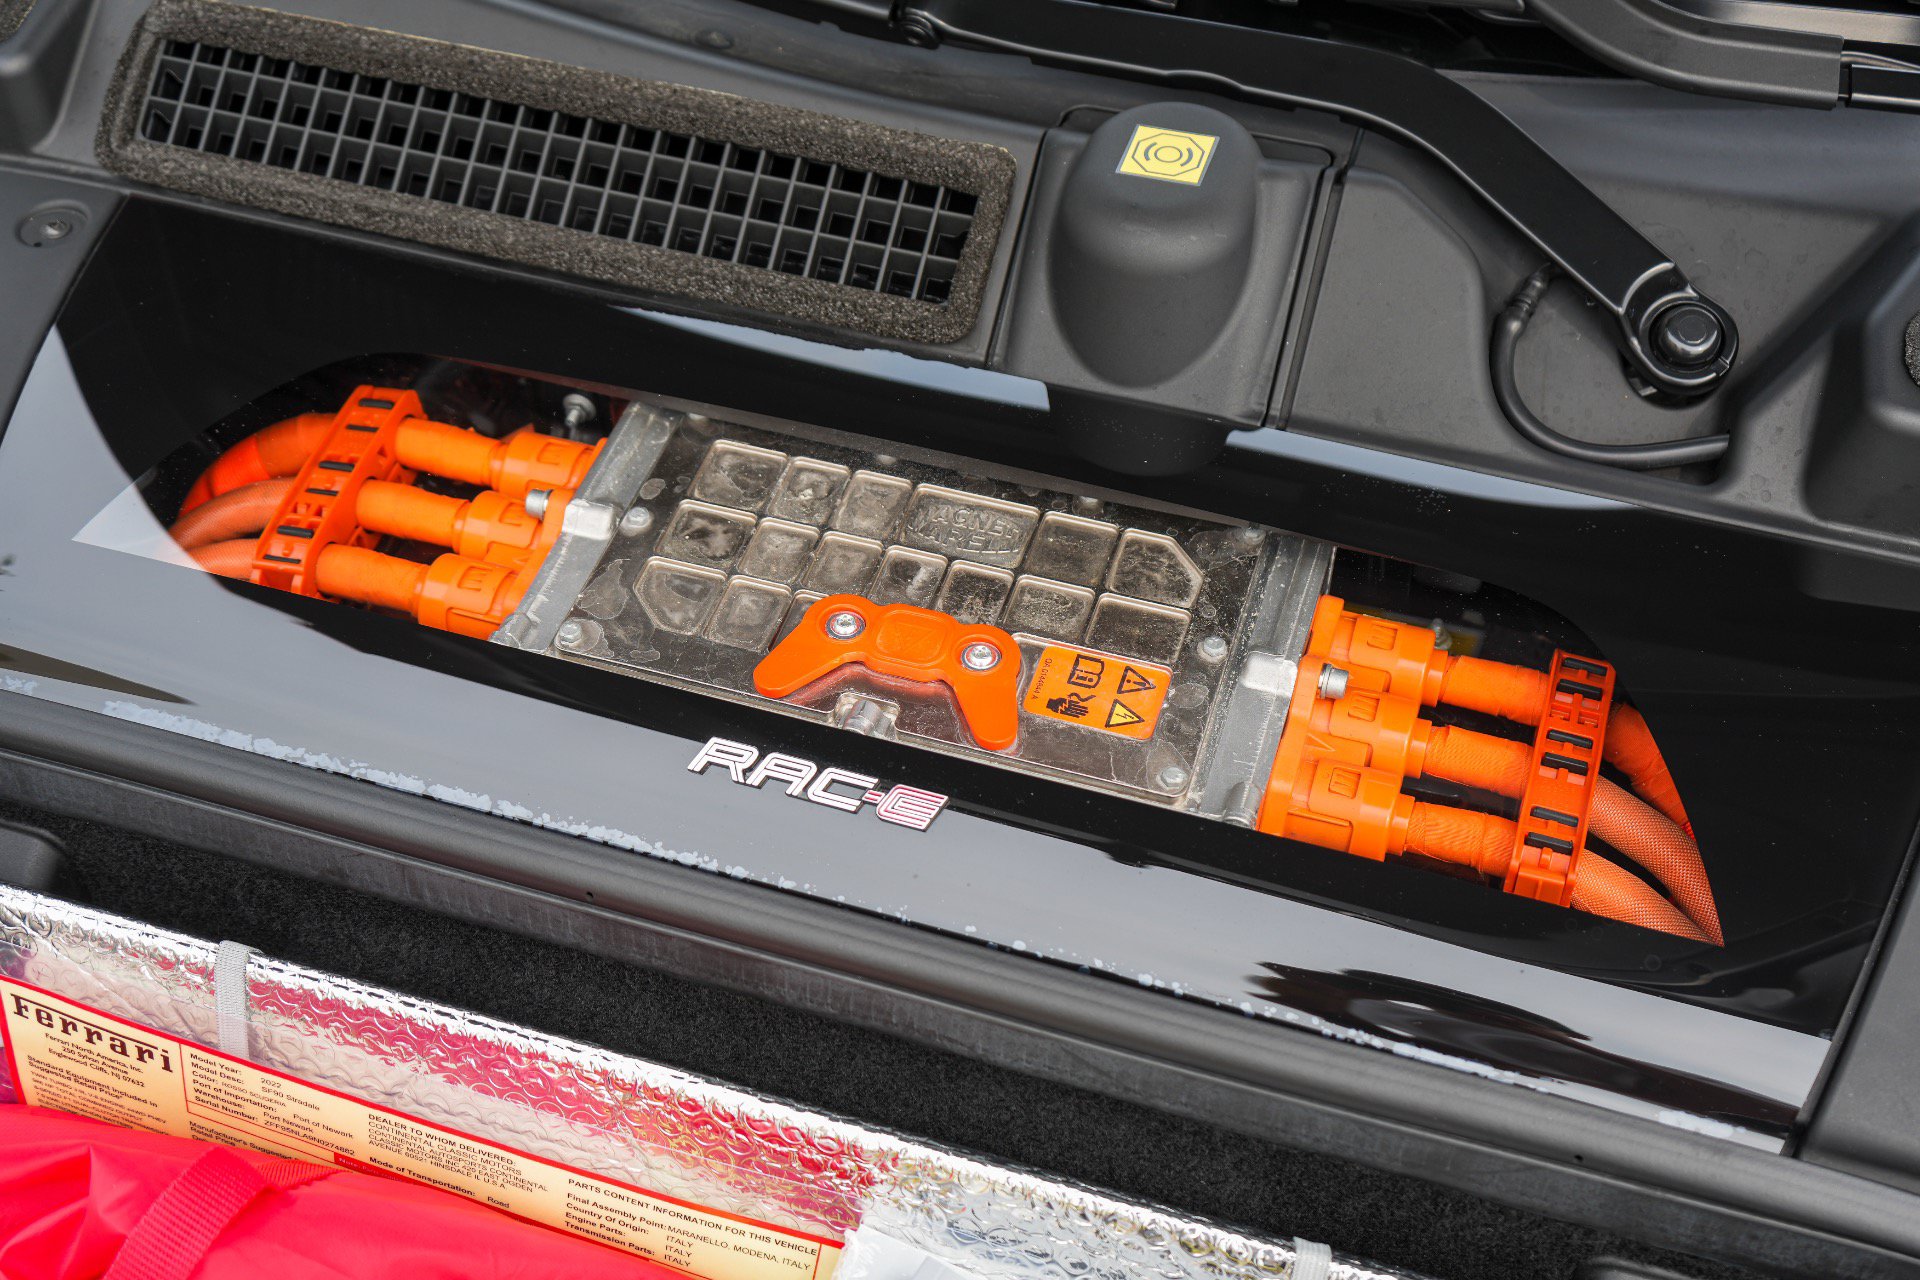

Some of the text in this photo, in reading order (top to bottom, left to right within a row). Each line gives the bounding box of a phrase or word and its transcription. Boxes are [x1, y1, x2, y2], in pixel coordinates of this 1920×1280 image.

[687, 736, 949, 832] RAC-E
[10, 993, 174, 1073] Ferrari
[44, 1032, 143, 1074] Ferrari North America, Inc.
[28, 1055, 63, 1073] Standard
[66, 1069, 110, 1091] Equipment
[28, 1060, 71, 1082] Suggested
[74, 1076, 96, 1090] Retail
[48, 1047, 88, 1067] Englewood
[90, 1063, 110, 1076] Cliffs,
[122, 1074, 144, 1088] 07632
[62, 1045, 128, 1075] 250 Sylvan Avenue
[190, 1053, 282, 1089] Model Year: 2022
[192, 1070, 218, 1083] Color:
[191, 1061, 320, 1110] Model Desc: SF90 Stradale
[192, 1078, 210, 1090] Port
[214, 1086, 222, 1094] of
[224, 1090, 277, 1112] Importation:
[293, 1113, 309, 1124] Port
[322, 1124, 352, 1138] Newark
[194, 1095, 219, 1108] Serial
[222, 1105, 258, 1121] Number:
[194, 1087, 313, 1133] Warehouse: Port Newark
[368, 1114, 515, 1166] DEALER TO WHOM DELIVERED:
[368, 1121, 521, 1176] CONTINENTAL CLASSIC MOTORS
[368, 1139, 402, 1155] AVENUE
[430, 1160, 471, 1177] HINSDALE
[368, 1128, 548, 1192] CONTINENTAL AUTOSPORTS CONTINENTAL
[368, 1134, 404, 1150] CLASSIC
[406, 1146, 442, 1162] MOTORS
[446, 1159, 459, 1168] INC
[478, 1170, 498, 1180] EAST
[502, 1178, 532, 1192] OGDEN
[370, 1156, 393, 1168] Mode
[406, 1168, 475, 1196] Transportation:
[488, 1196, 509, 1208] Road
[565, 1212, 692, 1258] Engine Parts: ITALY
[566, 1202, 693, 1248] Country Of Origin: ITALY
[567, 1192, 810, 1271] Final Assembly Point: MARANELLO, MODENA, ITALY
[568, 1178, 817, 1256] PARTS CONTENT INFORMATION FOR THIS VEHICLE
[564, 1220, 690, 1267] Transmission Parts: ITALY
